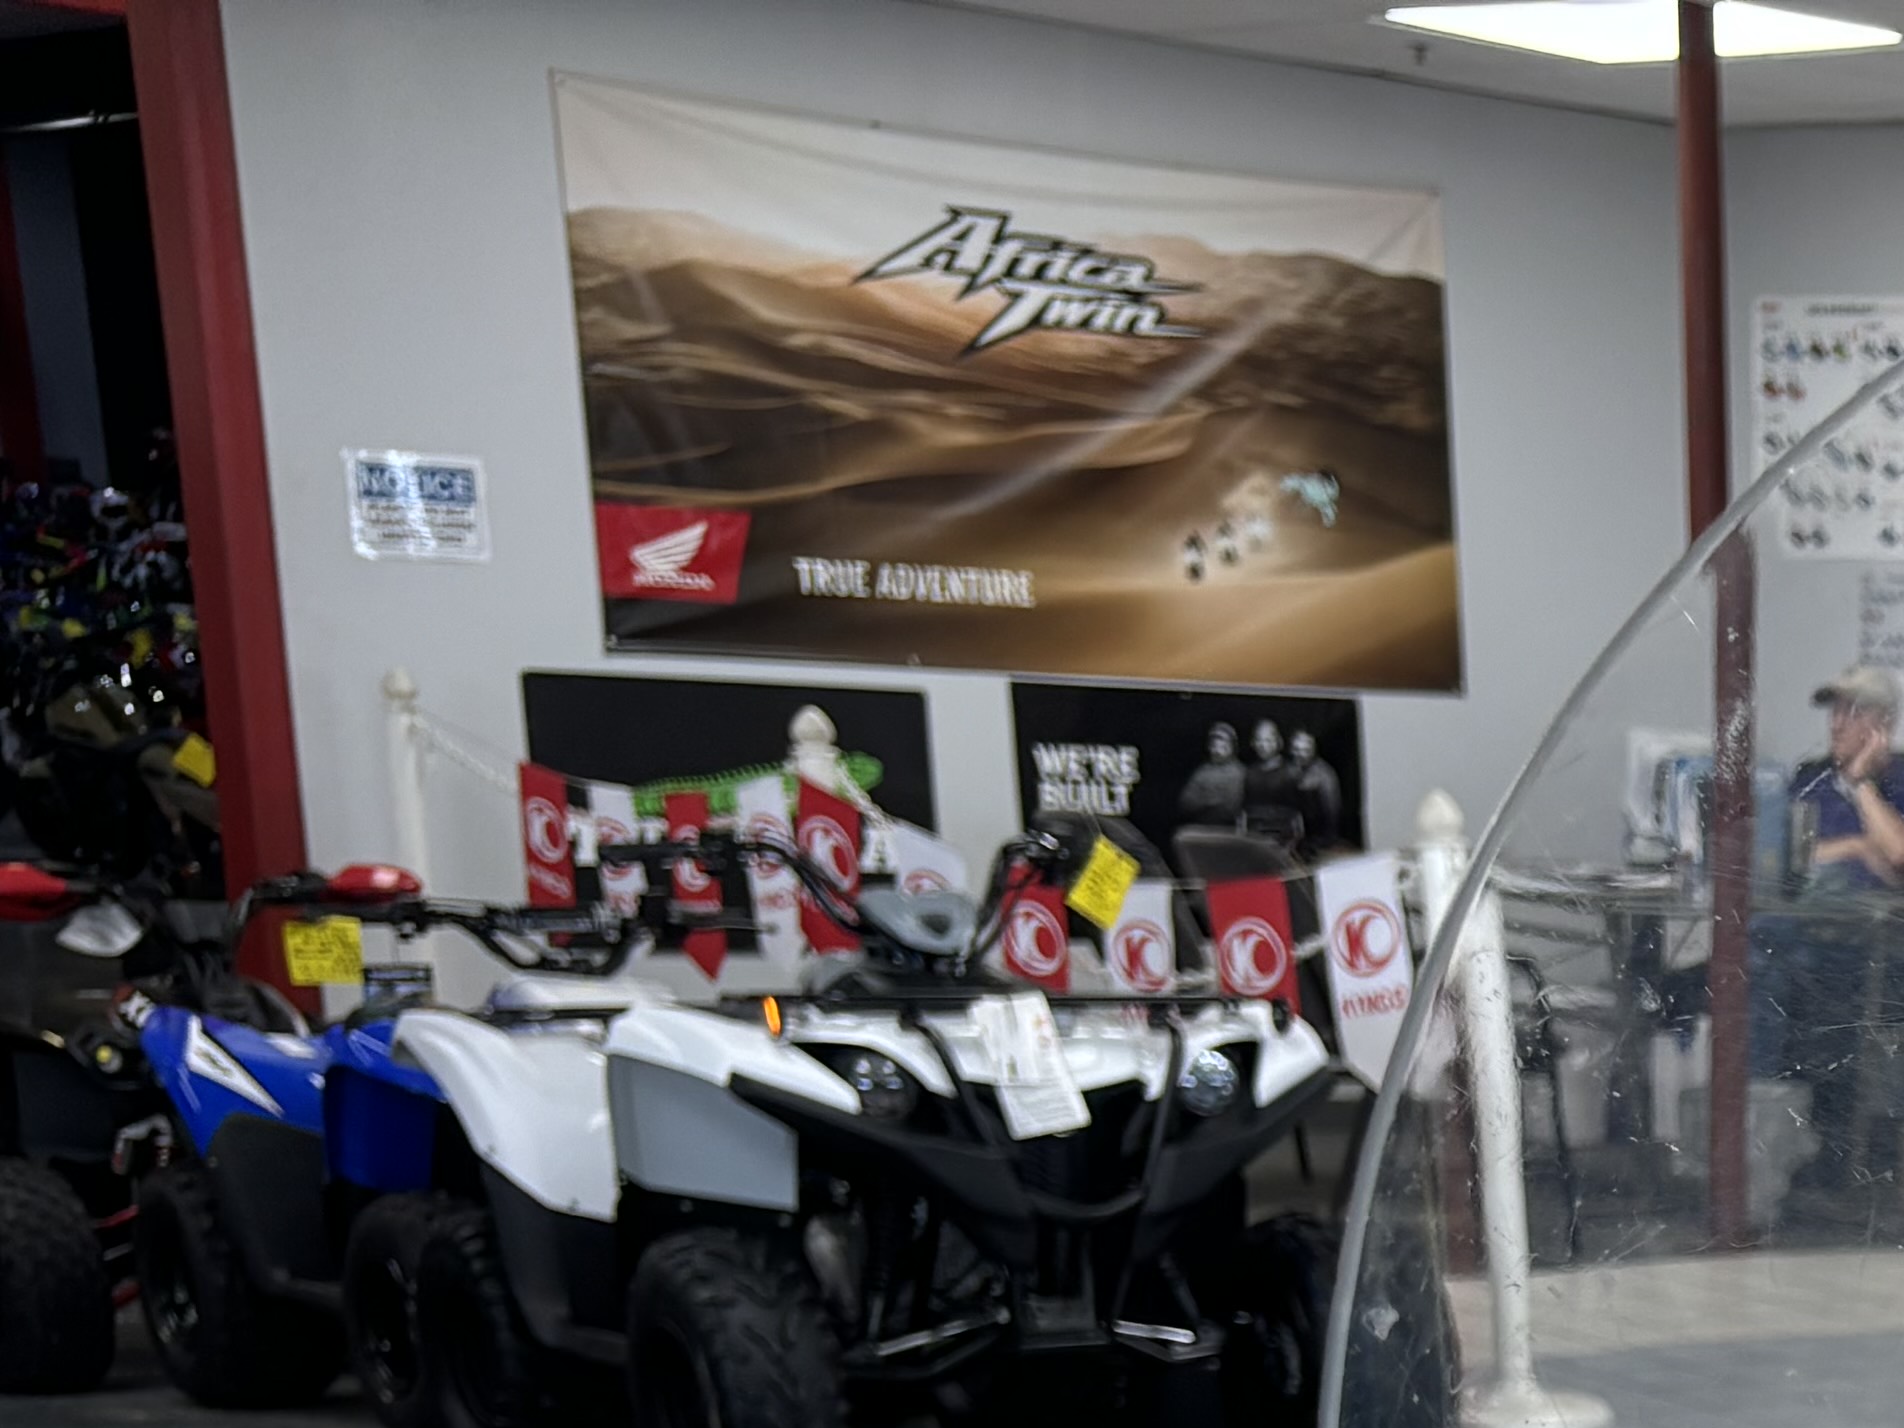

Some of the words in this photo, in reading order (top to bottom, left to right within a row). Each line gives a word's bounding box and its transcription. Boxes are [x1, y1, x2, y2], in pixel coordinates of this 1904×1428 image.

[850, 205, 1203, 301] Africa
[957, 281, 1205, 358] Twin
[792, 556, 871, 599] TRUE
[875, 561, 1036, 608] ADVENTURE
[1032, 742, 1140, 784] WE'RE
[1037, 781, 1131, 816] BUILT
